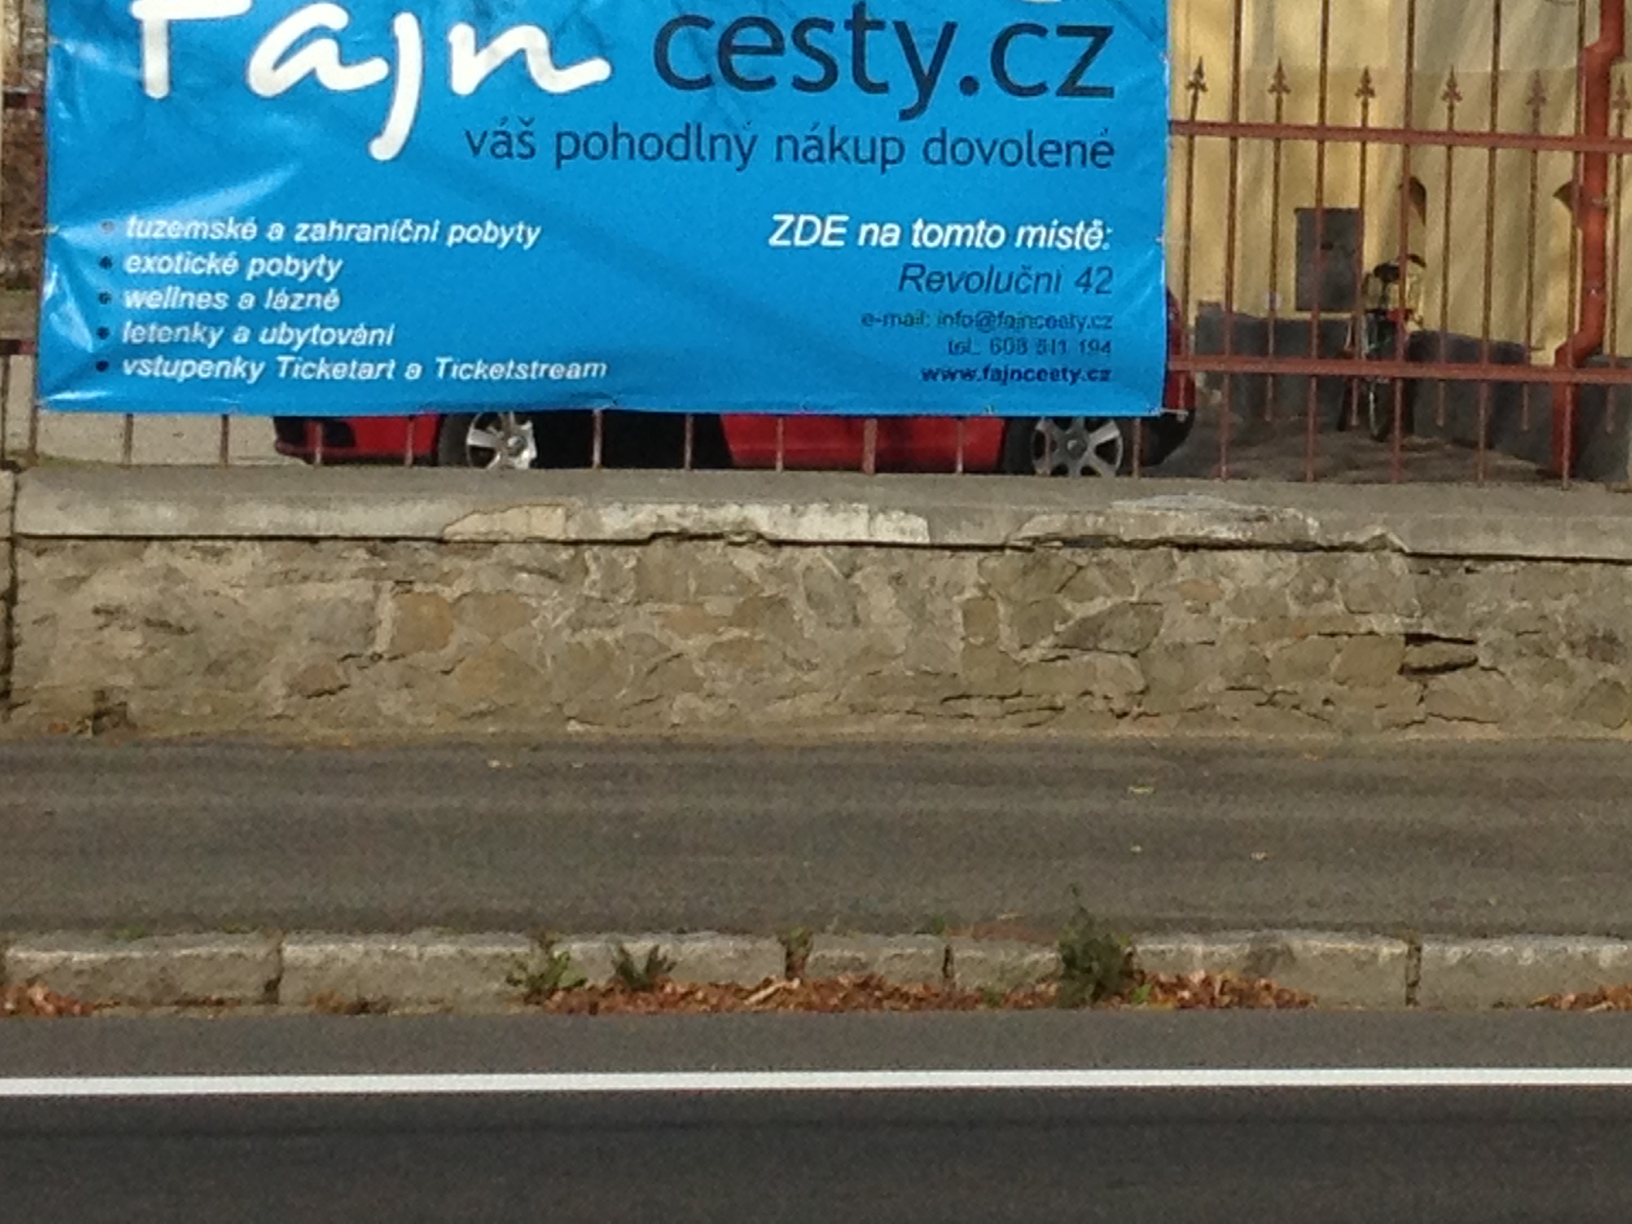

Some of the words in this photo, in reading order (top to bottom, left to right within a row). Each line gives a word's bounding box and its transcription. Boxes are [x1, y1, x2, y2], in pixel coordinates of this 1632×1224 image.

[652, 1, 1115, 121] cesty.cz
[465, 116, 536, 161] váš
[555, 121, 758, 169] pohodlný
[775, 123, 905, 173] nákup
[922, 128, 1115, 169] dovolené
[126, 215, 258, 241] tuzemské
[266, 222, 285, 243] a
[294, 219, 441, 246] zahraniční
[446, 219, 542, 251] pobyty
[768, 214, 850, 248] ZDE
[857, 221, 901, 248] na
[911, 217, 1007, 249] tomto
[123, 251, 240, 275] exotické
[246, 253, 344, 283] pobyty
[898, 262, 1065, 295] Revoluční
[1074, 266, 1114, 295] 42
[124, 285, 230, 310] wellnes
[238, 292, 256, 311] a
[264, 286, 341, 312] lázně
[122, 321, 224, 350] letenky
[232, 328, 251, 346] a
[258, 322, 396, 352] ubytování
[122, 355, 266, 384] vstupenky
[276, 355, 397, 381] Ticketart
[405, 362, 423, 381] a
[435, 356, 608, 382] Ticketstream
